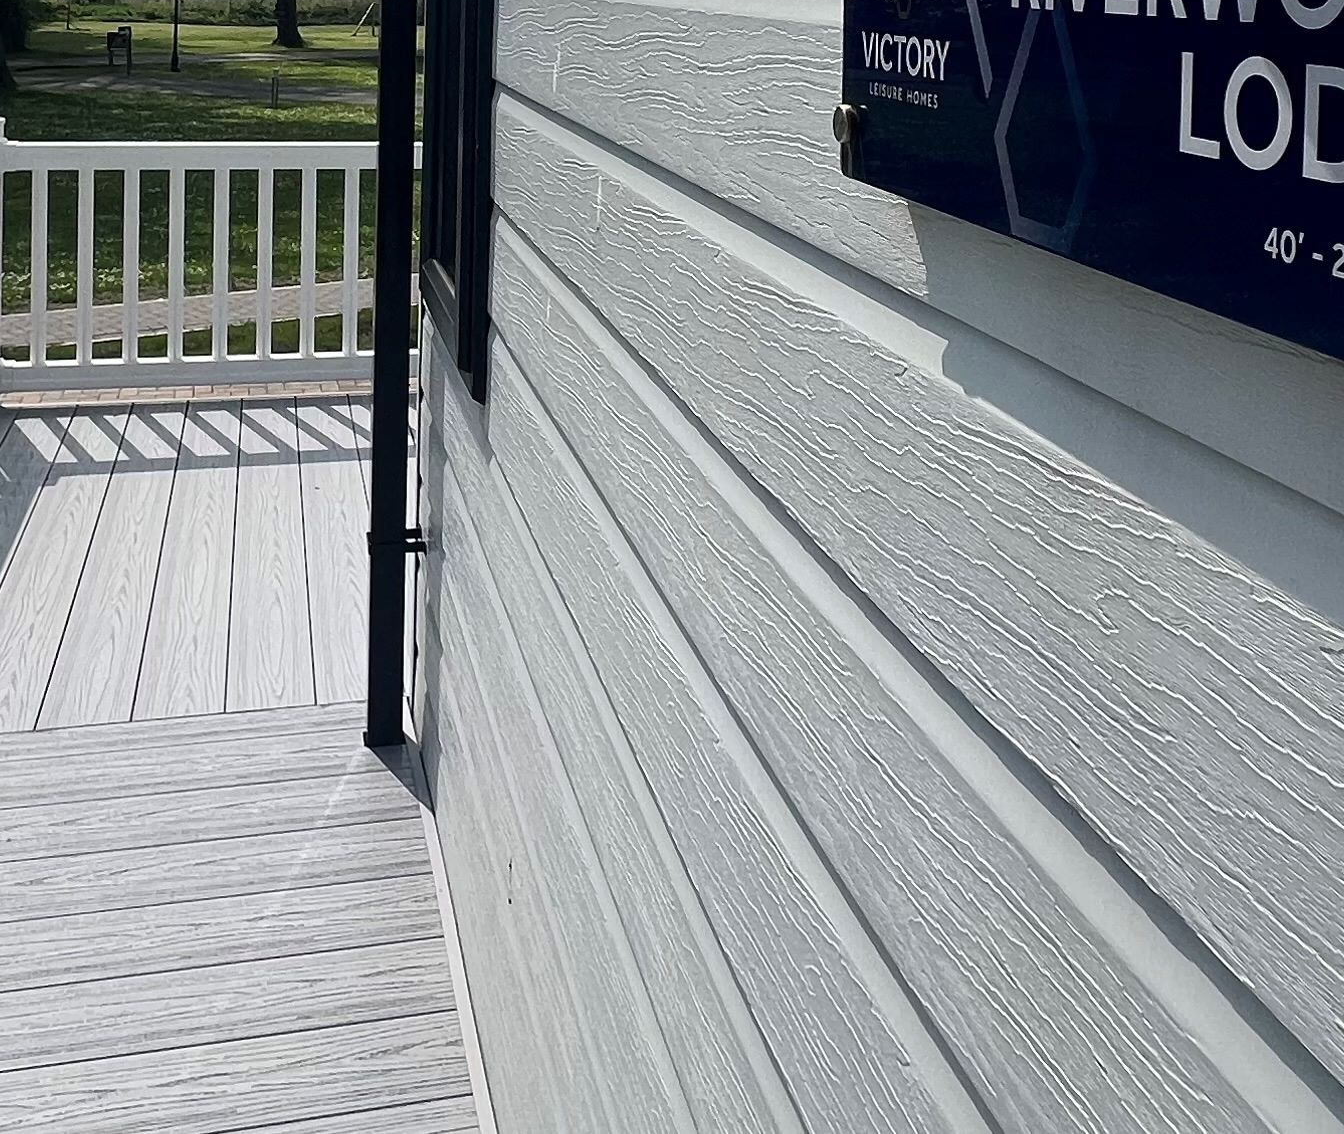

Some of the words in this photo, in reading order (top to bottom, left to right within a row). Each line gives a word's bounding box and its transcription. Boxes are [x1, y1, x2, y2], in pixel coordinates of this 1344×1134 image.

[861, 31, 950, 81] VICTORY
[869, 81, 903, 102] LEISURE
[905, 88, 939, 109] HOMES
